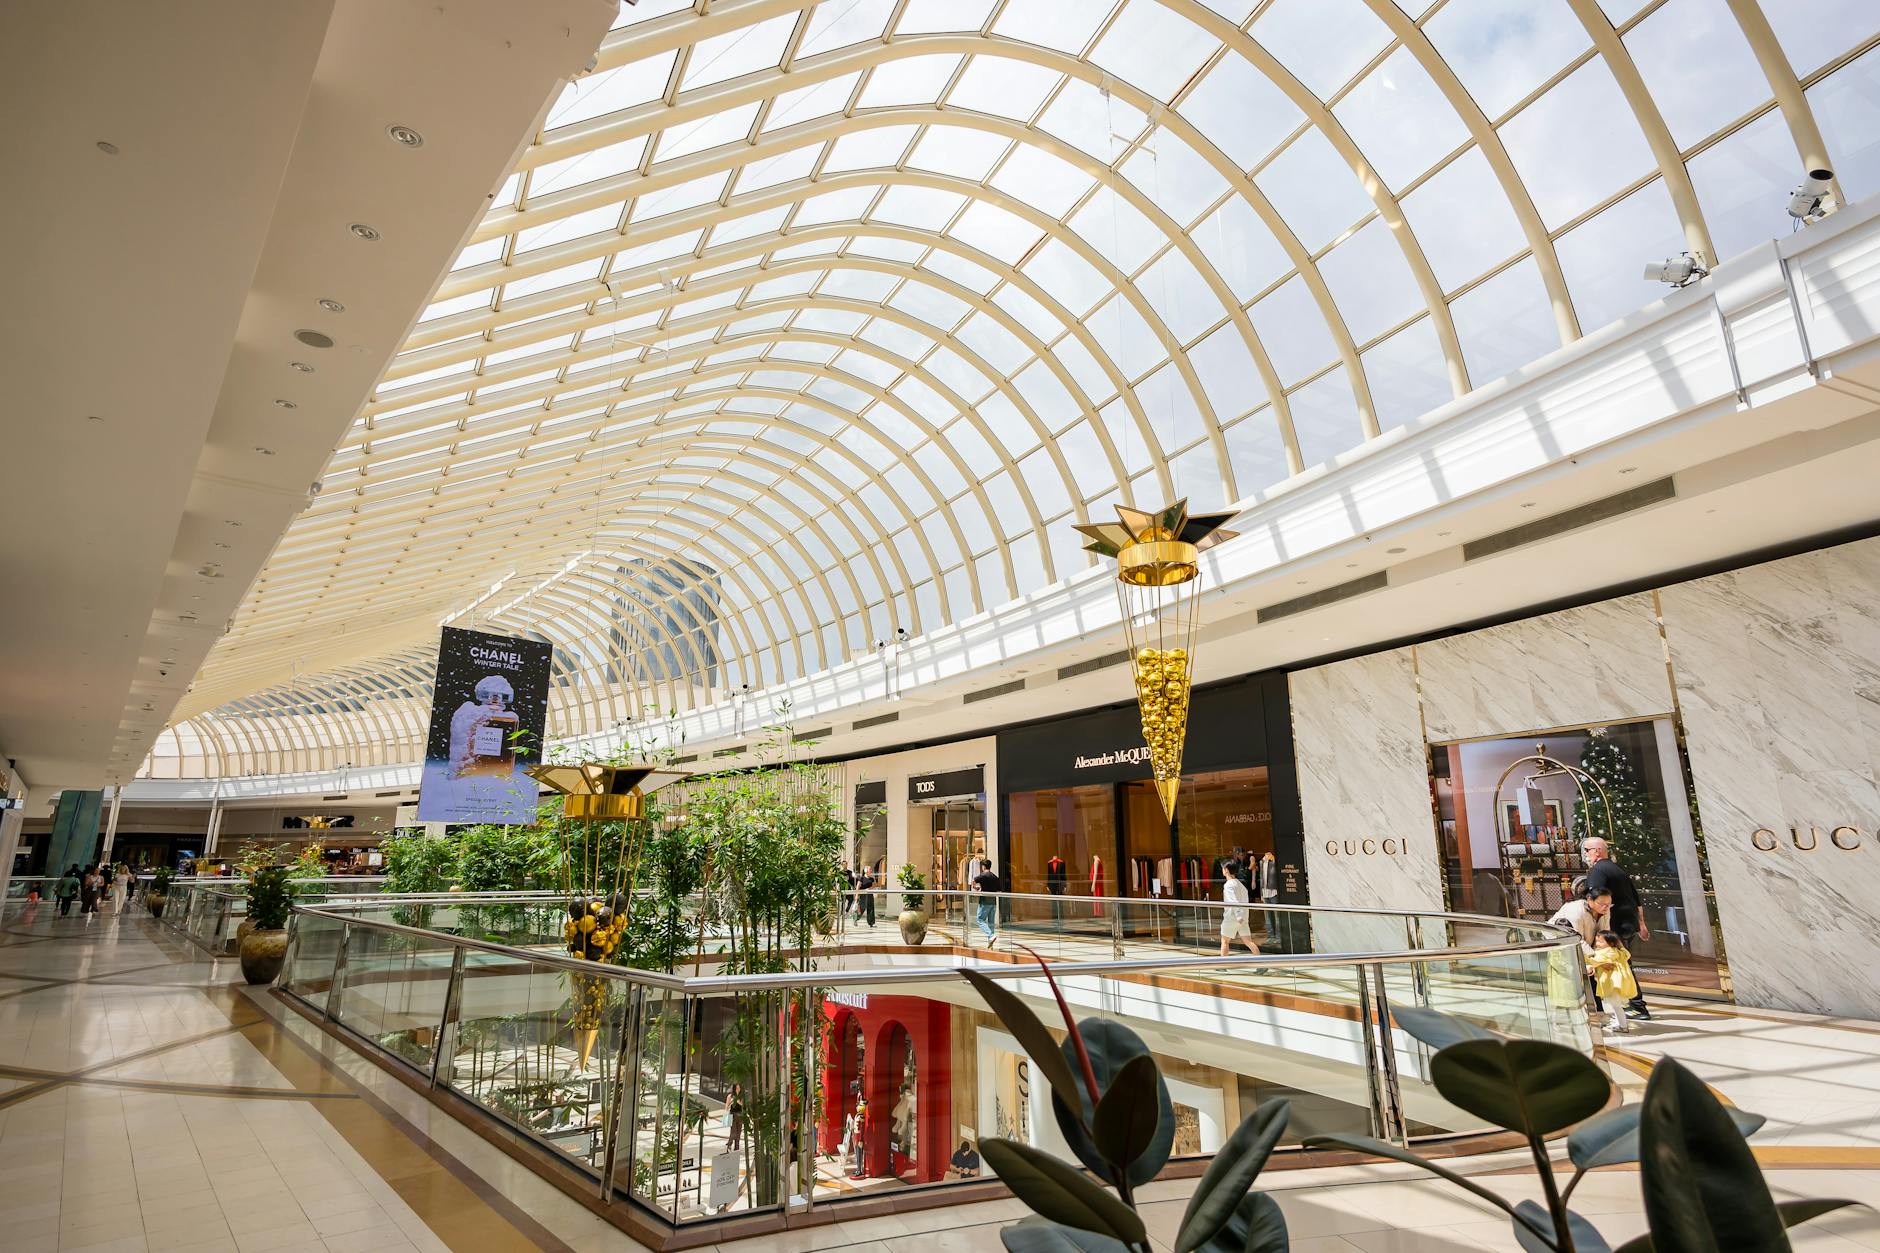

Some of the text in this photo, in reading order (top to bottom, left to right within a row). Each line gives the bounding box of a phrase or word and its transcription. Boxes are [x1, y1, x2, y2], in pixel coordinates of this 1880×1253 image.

[470, 647, 524, 664] CHANEL
[474, 659, 519, 670] WINTER TALE
[1074, 746, 1153, 769] Alexander McQUE
[1325, 838, 1407, 856] GUCCI
[1750, 826, 1880, 851] GUC
